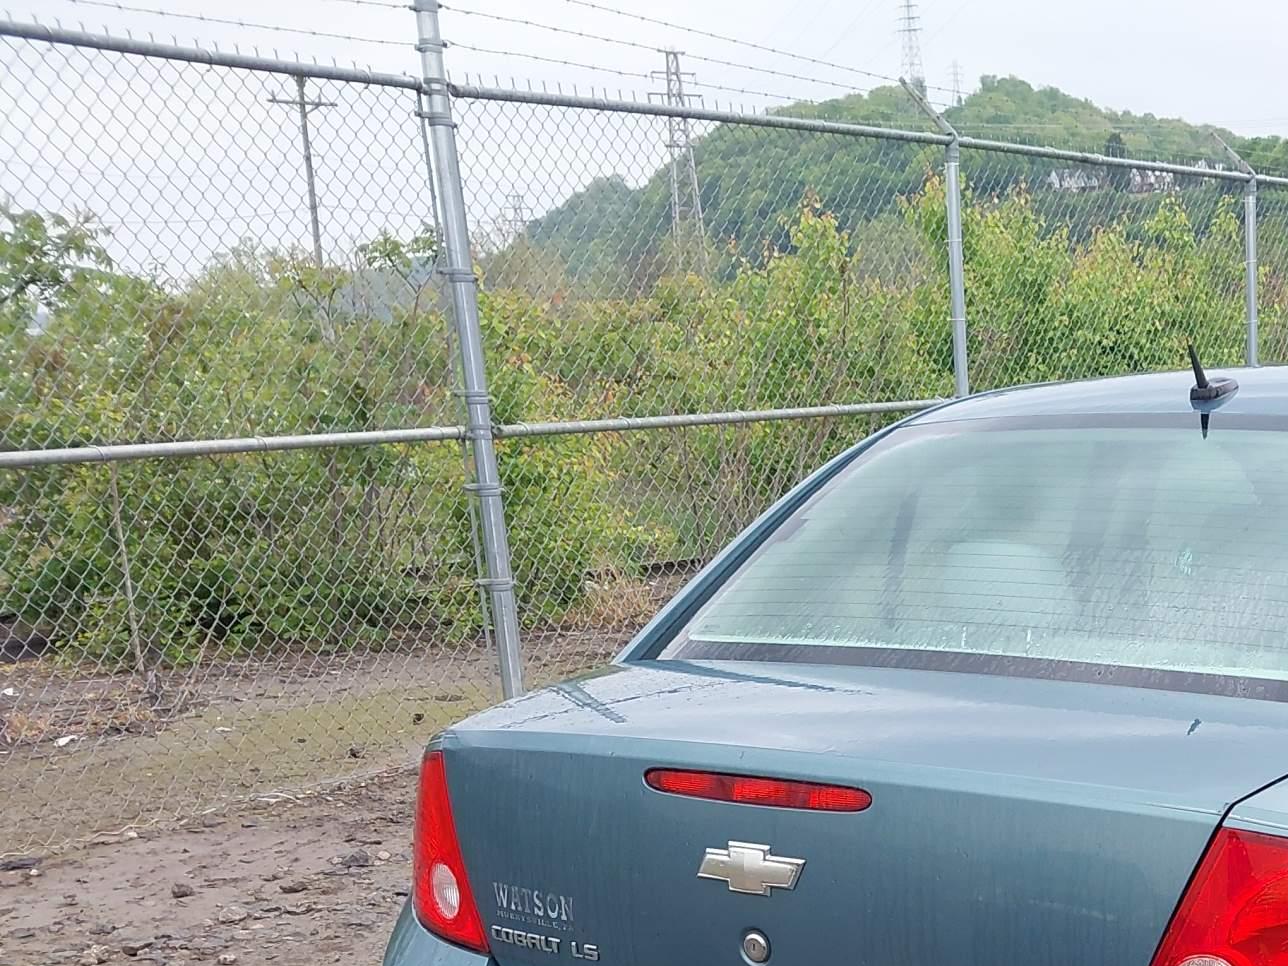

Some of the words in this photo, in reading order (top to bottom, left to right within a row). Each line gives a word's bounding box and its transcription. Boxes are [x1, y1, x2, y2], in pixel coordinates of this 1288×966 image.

[492, 882, 575, 922] WATSON
[491, 924, 561, 954] COBALT
[570, 941, 599, 961] LS
